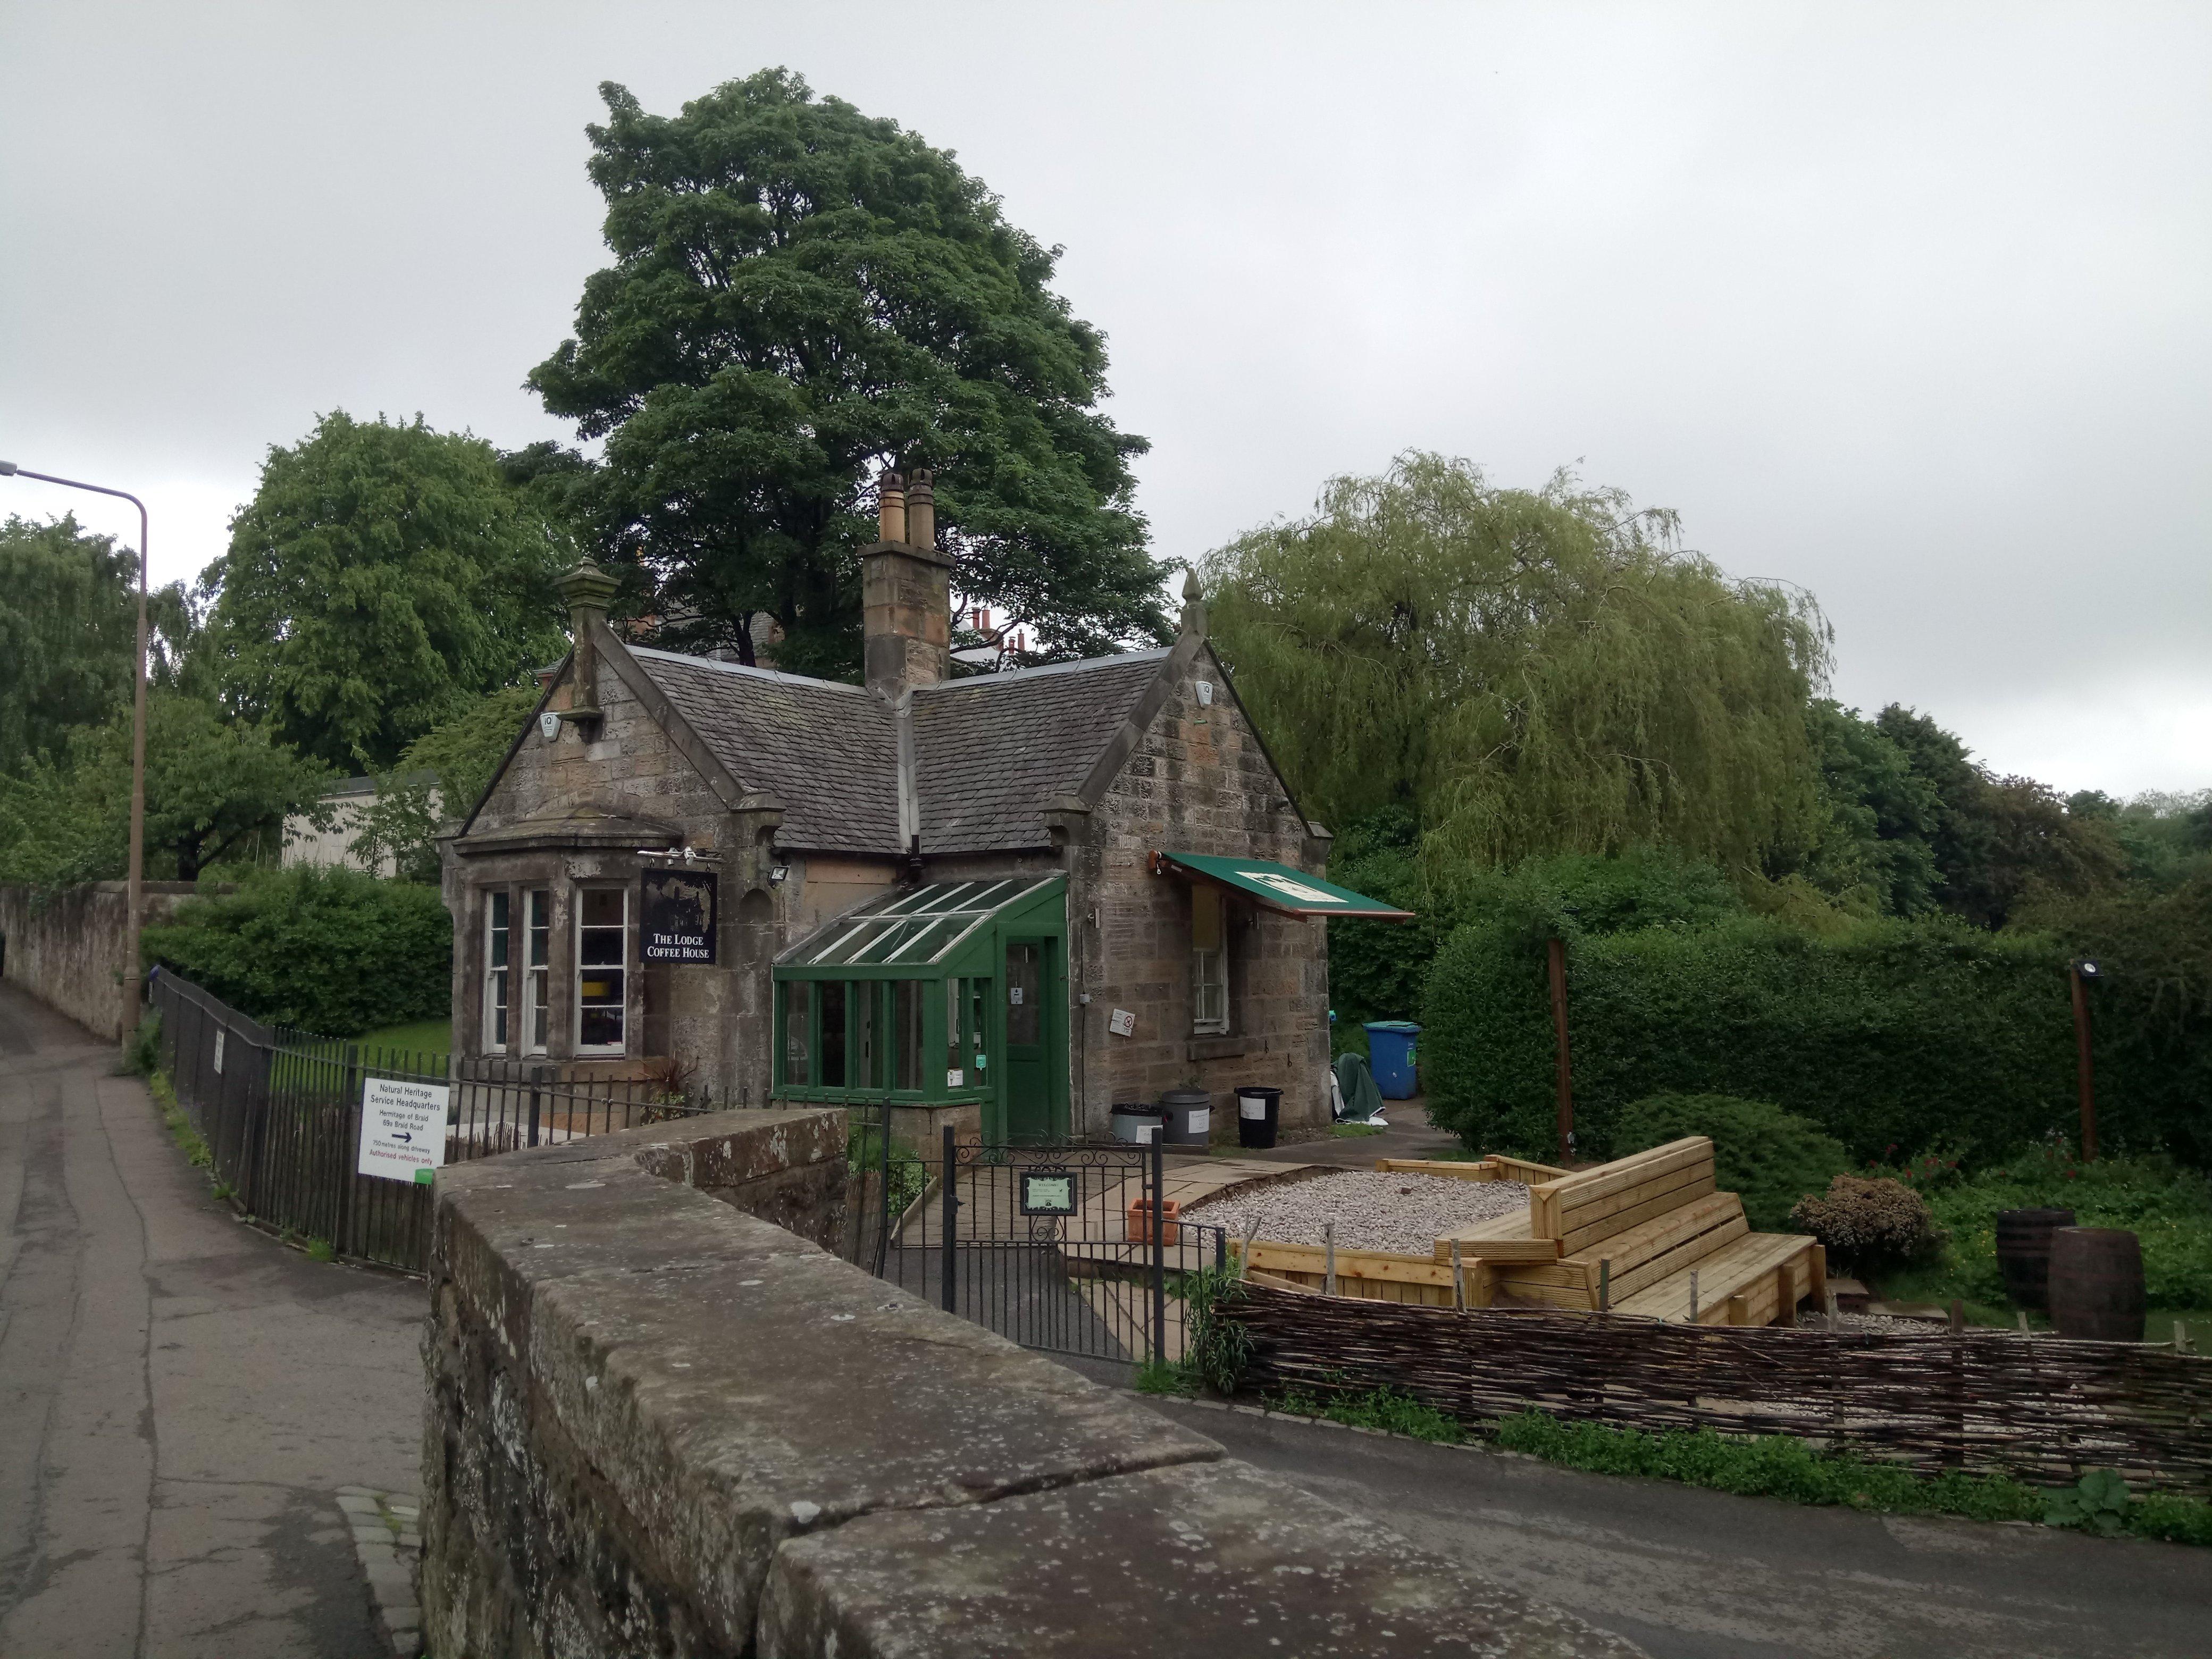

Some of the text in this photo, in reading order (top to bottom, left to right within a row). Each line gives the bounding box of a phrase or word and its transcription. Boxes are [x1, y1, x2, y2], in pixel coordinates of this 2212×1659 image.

[653, 933, 703, 945] THE LODGE
[647, 946, 709, 958] COFFEE HOUSE
[380, 1084, 432, 1099] Natural Heritage
[371, 1095, 440, 1111] Service Headquarters
[379, 1109, 405, 1119] Hermitage
[369, 1149, 397, 1159] Authorised
[398, 1154, 419, 1163] vehicles
[411, 1146, 430, 1154] driveway
